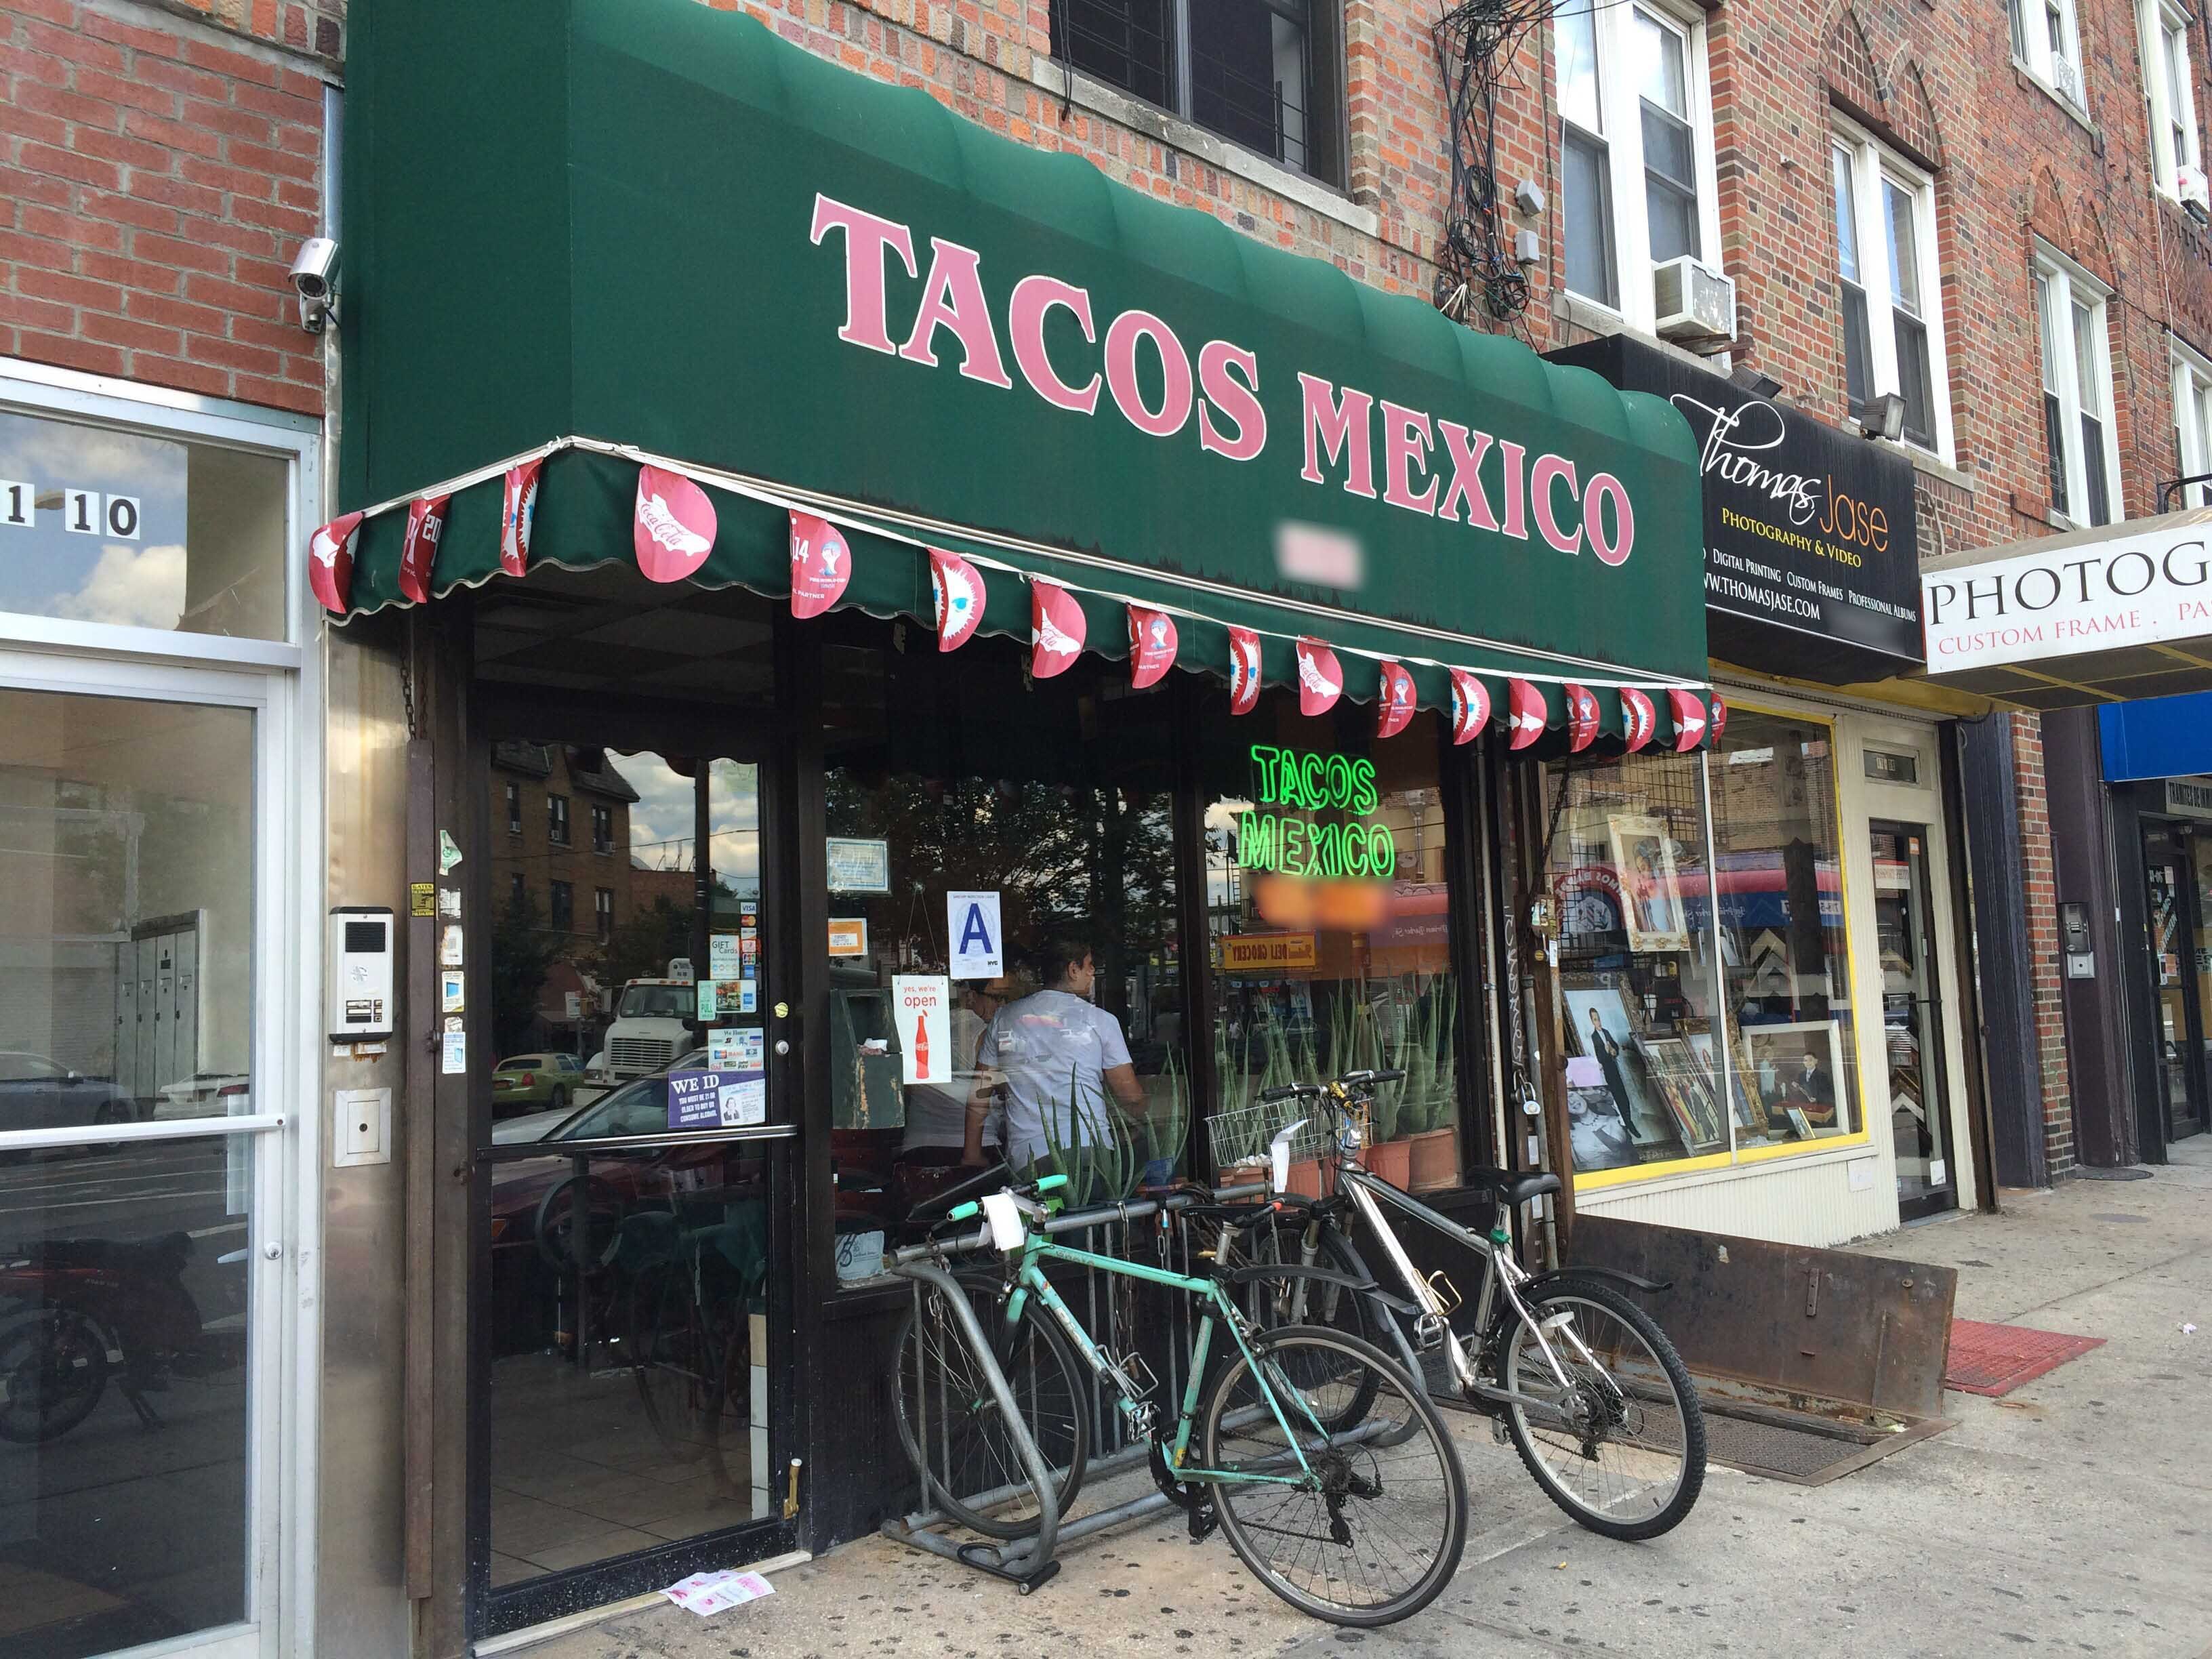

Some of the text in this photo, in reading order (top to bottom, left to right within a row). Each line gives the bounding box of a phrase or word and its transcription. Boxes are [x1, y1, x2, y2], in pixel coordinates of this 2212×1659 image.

[811, 192, 1635, 567] TACOS MEXICO
[1670, 394, 1888, 552] Thomas Jase
[73, 493, 137, 535] 10
[1722, 508, 1862, 568] PHOTOGRAPHY & VIDEO
[1713, 548, 1744, 571] DIGITAL
[1746, 558, 1781, 582] PRINTING
[1787, 572, 1816, 593] CUSTOM
[1818, 581, 1843, 601] FRAMES
[1849, 590, 1892, 615] PROFESSIONAL
[1893, 605, 1917, 622] ALBUMS
[1927, 541, 2211, 625] PHOTOG
[1939, 600, 2212, 655] CUSTOM FRAME PA
[1251, 745, 1378, 816] TACOS
[1237, 810, 1395, 878] MEXICO
[959, 903, 994, 954] A
[905, 997, 937, 1008] open
[671, 1078, 699, 1094] WE
[703, 1075, 719, 1089] ID
[681, 1105, 694, 1113] OLDER
[688, 1095, 698, 1103] MUST
